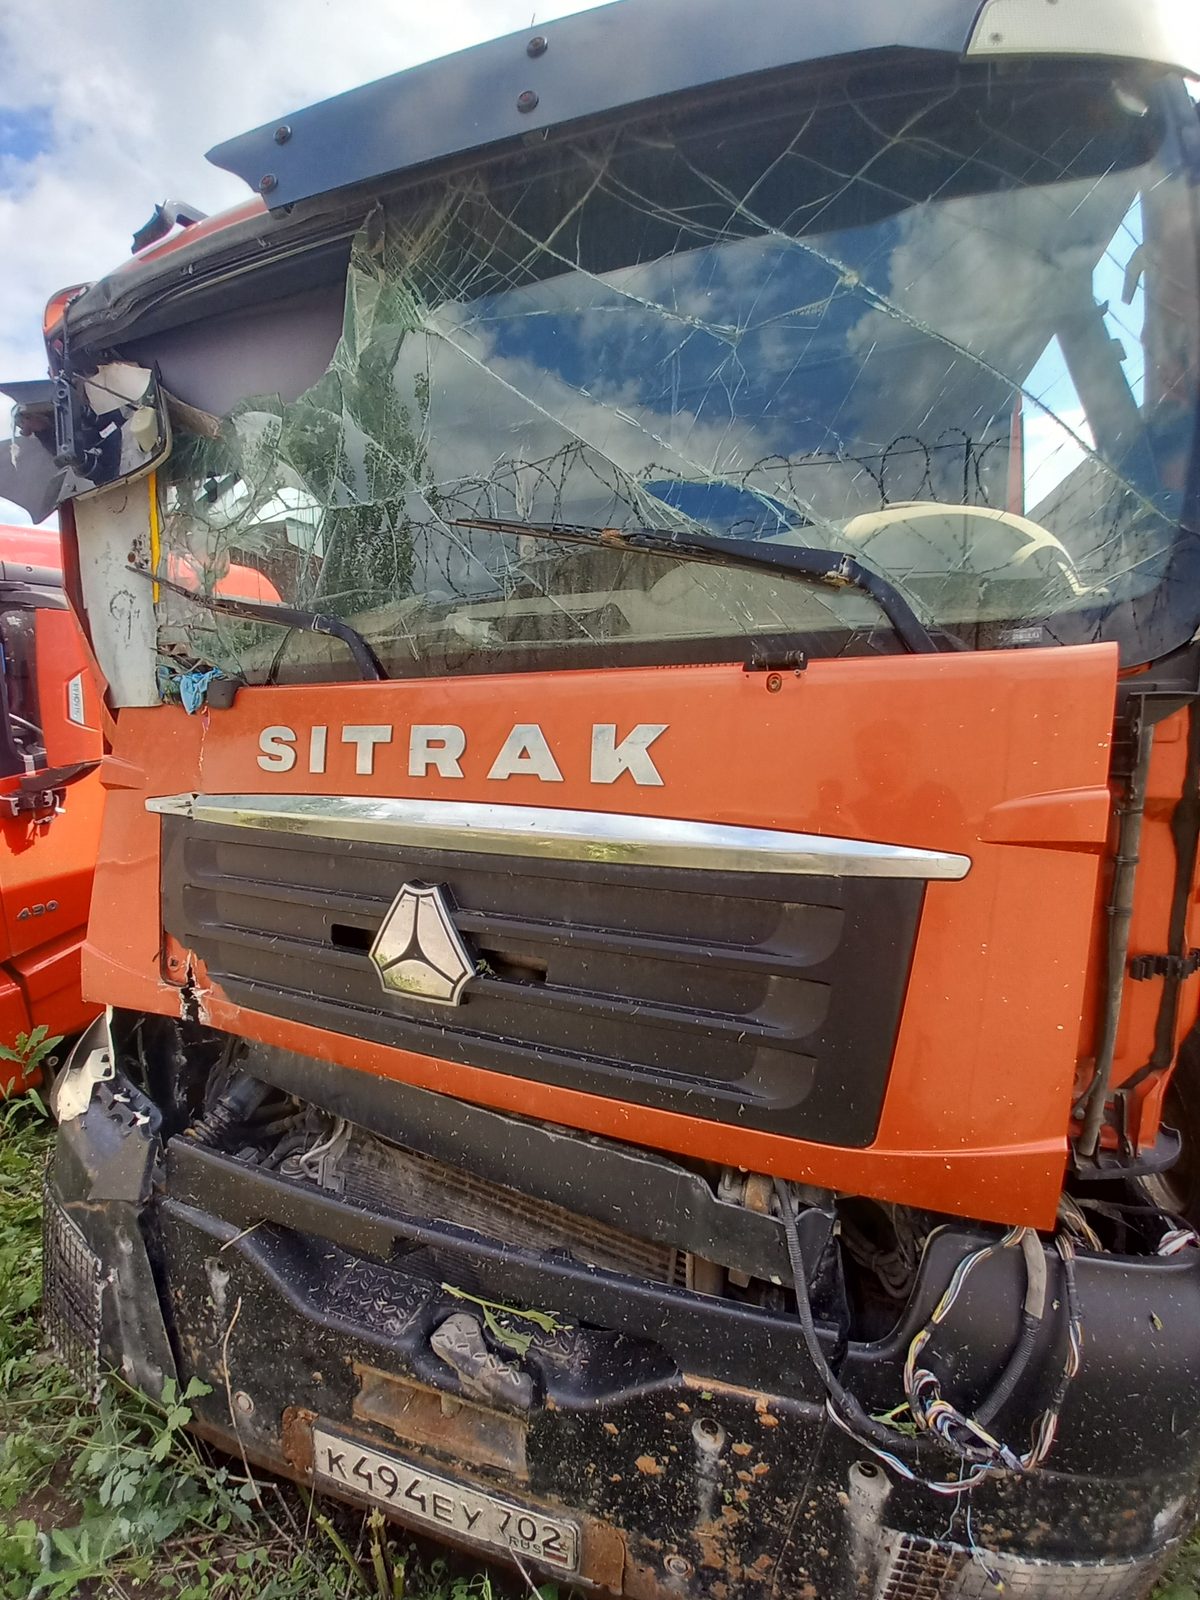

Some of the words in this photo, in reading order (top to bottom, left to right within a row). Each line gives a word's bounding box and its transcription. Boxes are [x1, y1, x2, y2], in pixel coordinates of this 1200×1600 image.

[256, 723, 670, 786] SITRAK
[499, 1507, 561, 1553] 702
[508, 1535, 542, 1554] RUS
